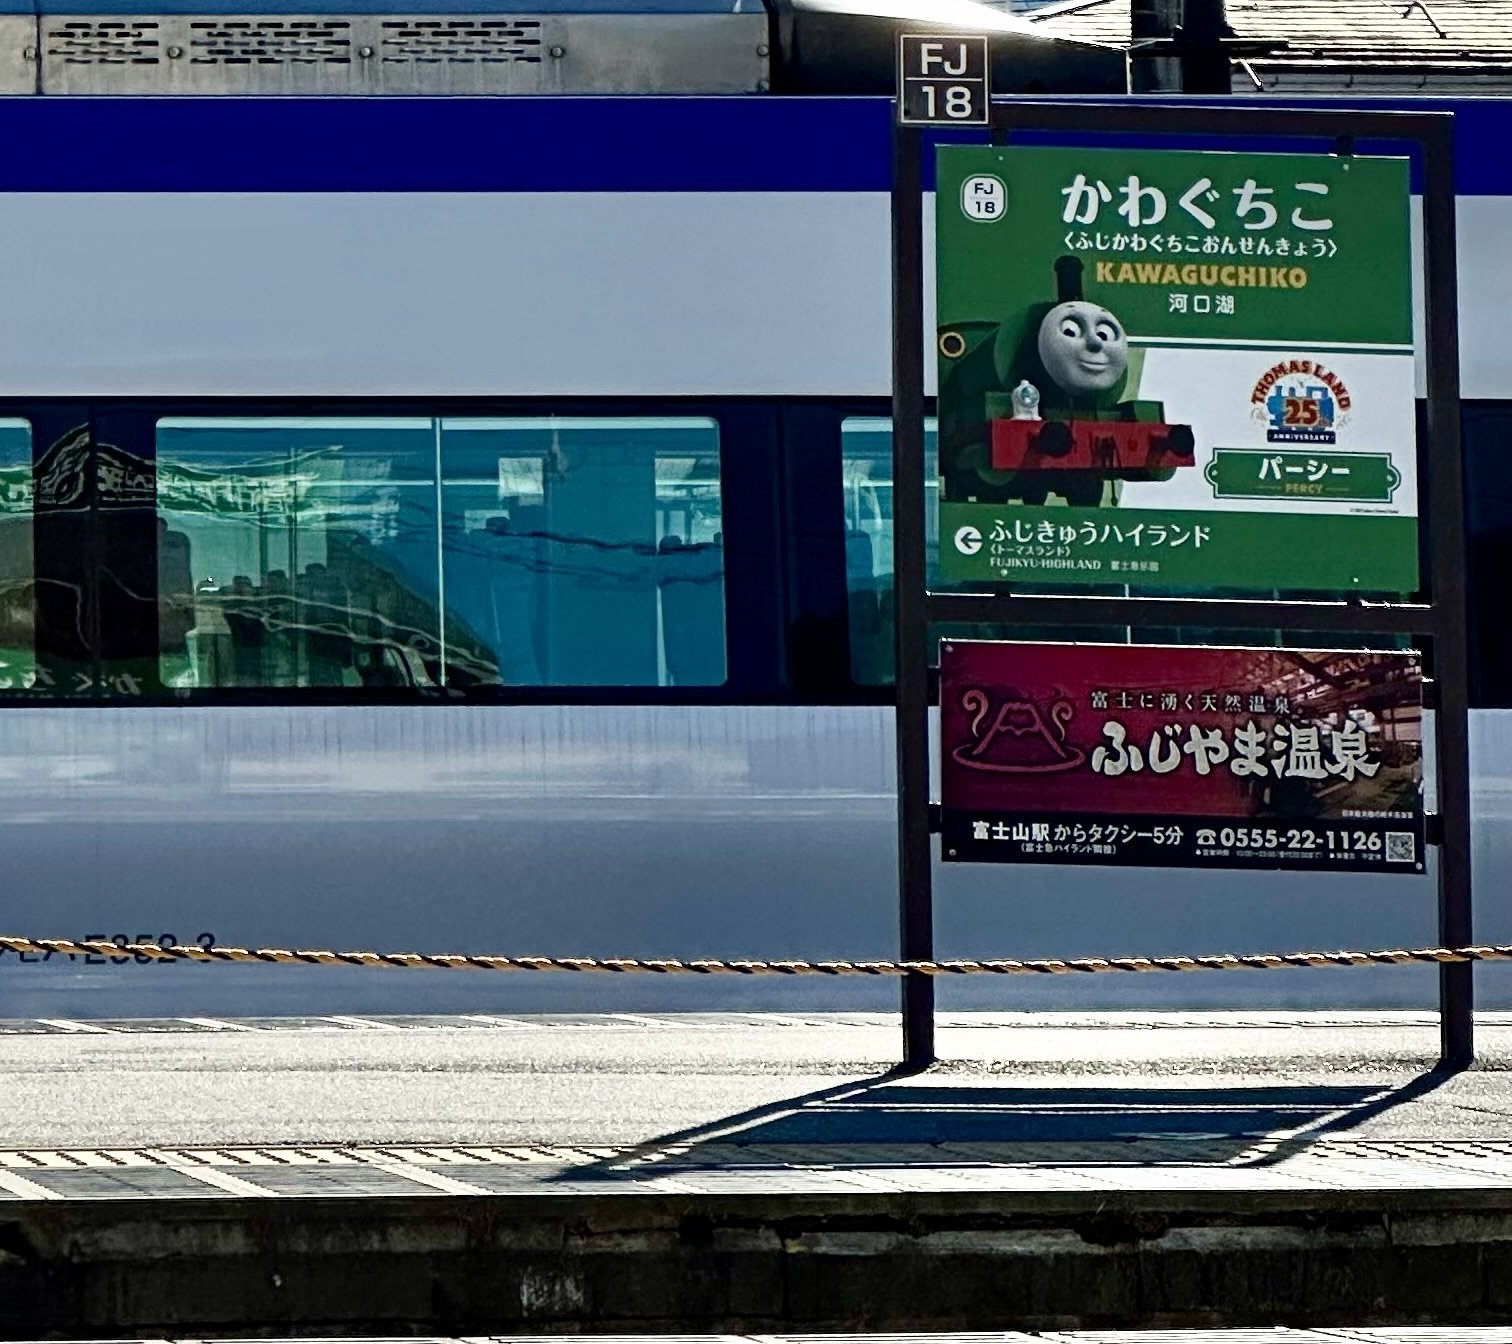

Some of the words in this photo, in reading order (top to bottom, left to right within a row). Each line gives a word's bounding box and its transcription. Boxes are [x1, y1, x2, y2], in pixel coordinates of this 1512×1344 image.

[920, 43, 967, 76] FJ
[921, 85, 973, 118] 18
[974, 182, 994, 195] FJ
[1061, 173, 1334, 231] かわぐちこ
[975, 201, 995, 214] 18
[1096, 262, 1308, 289] KAWAGUCHIKO
[1168, 293, 1235, 314] 河口湖
[1251, 360, 1313, 405] THOMAS
[1313, 363, 1352, 411] LAND
[1258, 455, 1350, 482] パーシー
[1285, 483, 1323, 495] PERCY
[989, 519, 1211, 548] ふじきゅうハイランド
[1091, 691, 1290, 714] 富士に湧く天然温泉
[1091, 720, 1381, 782] ふじやま温泉
[1220, 827, 1383, 851] 0555-22-1126
